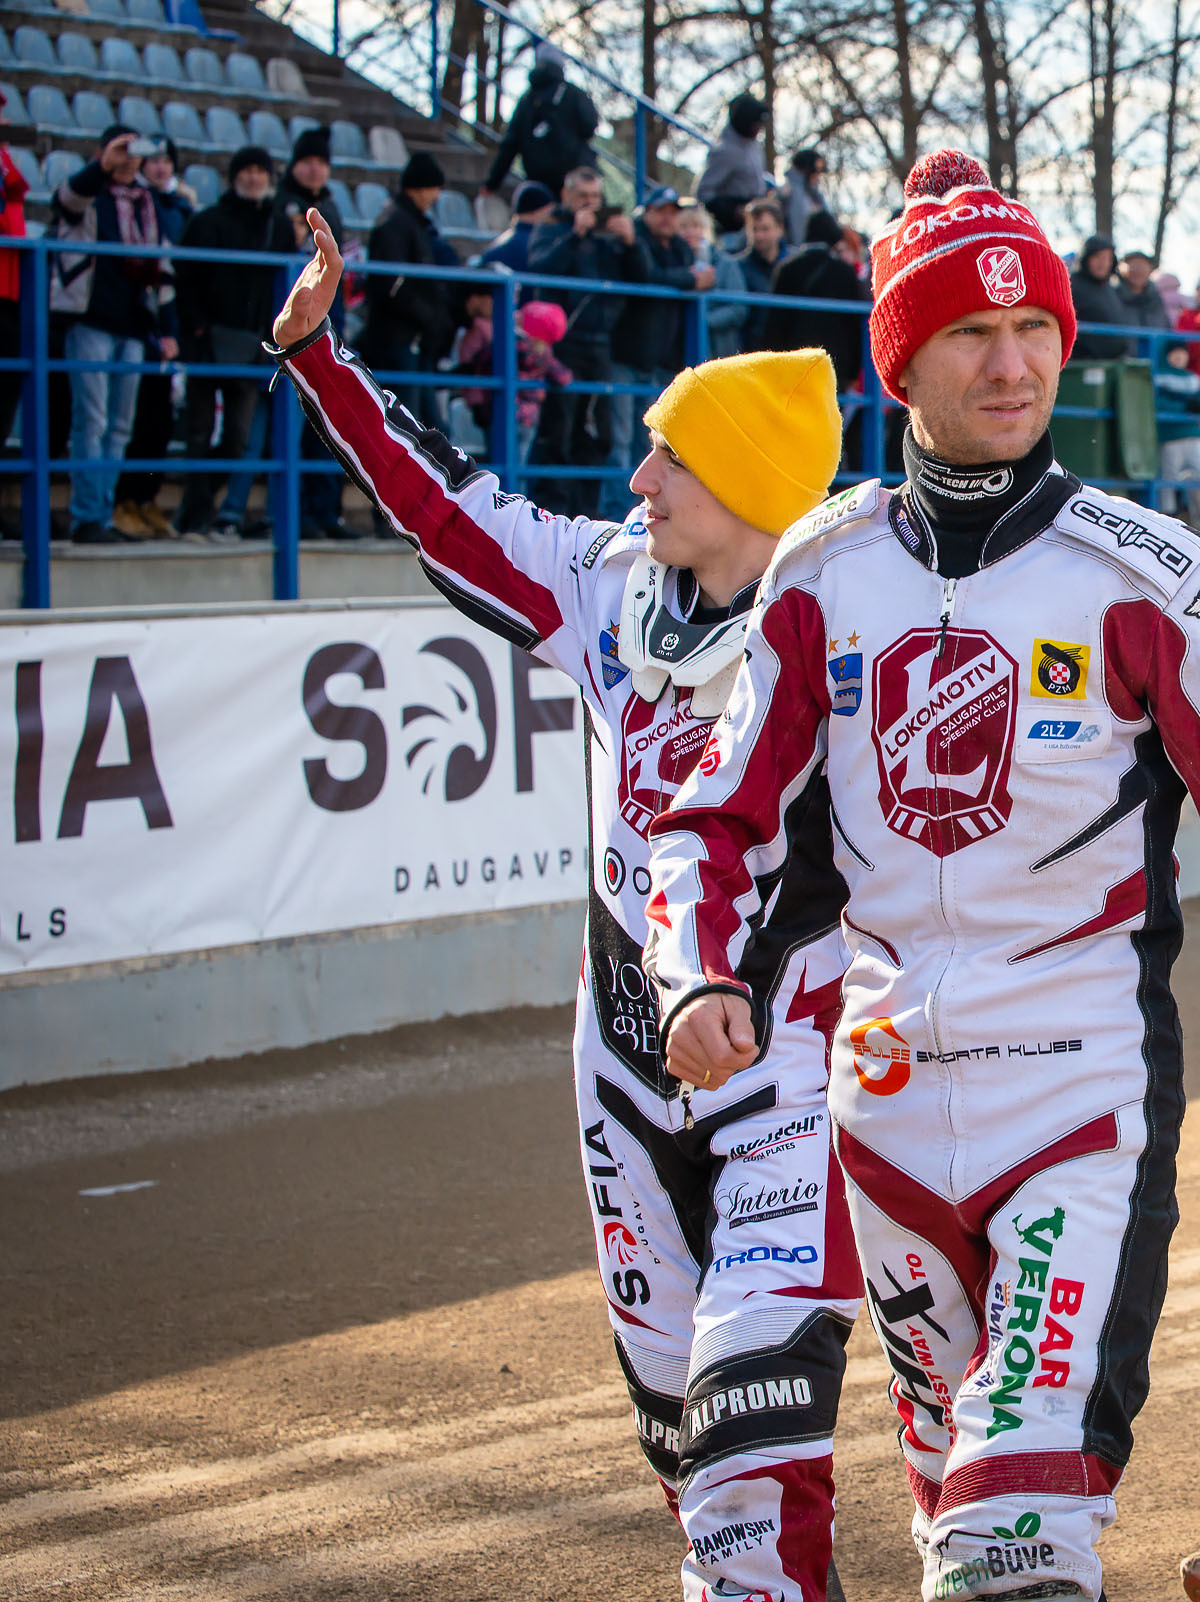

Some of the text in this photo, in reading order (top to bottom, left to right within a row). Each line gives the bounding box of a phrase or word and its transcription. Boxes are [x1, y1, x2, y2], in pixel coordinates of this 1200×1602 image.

[885, 654, 996, 759] LOKOMOTIV
[939, 684, 1008, 736] DAUGAVPILS
[1047, 682, 1072, 694] PZM
[939, 699, 1007, 749] SPEEDWAY CLUB
[1040, 722, 1066, 738] 2LŻ
[395, 846, 590, 894] DAUGAVP
[1007, 1039, 1083, 1057] KLUBS
[766, 1141, 797, 1158] PLATES
[714, 1178, 824, 1220] Interio
[712, 1245, 819, 1274] TRODO
[905, 1252, 927, 1281] TO
[905, 1323, 935, 1367] WAY
[987, 1206, 1067, 1441] VERONA
[1031, 1277, 1086, 1389] BAR
[691, 1378, 813, 1438] ALPROMO
[699, 1535, 764, 1568] FAMILY
[934, 1542, 1055, 1601] GreenBūve
